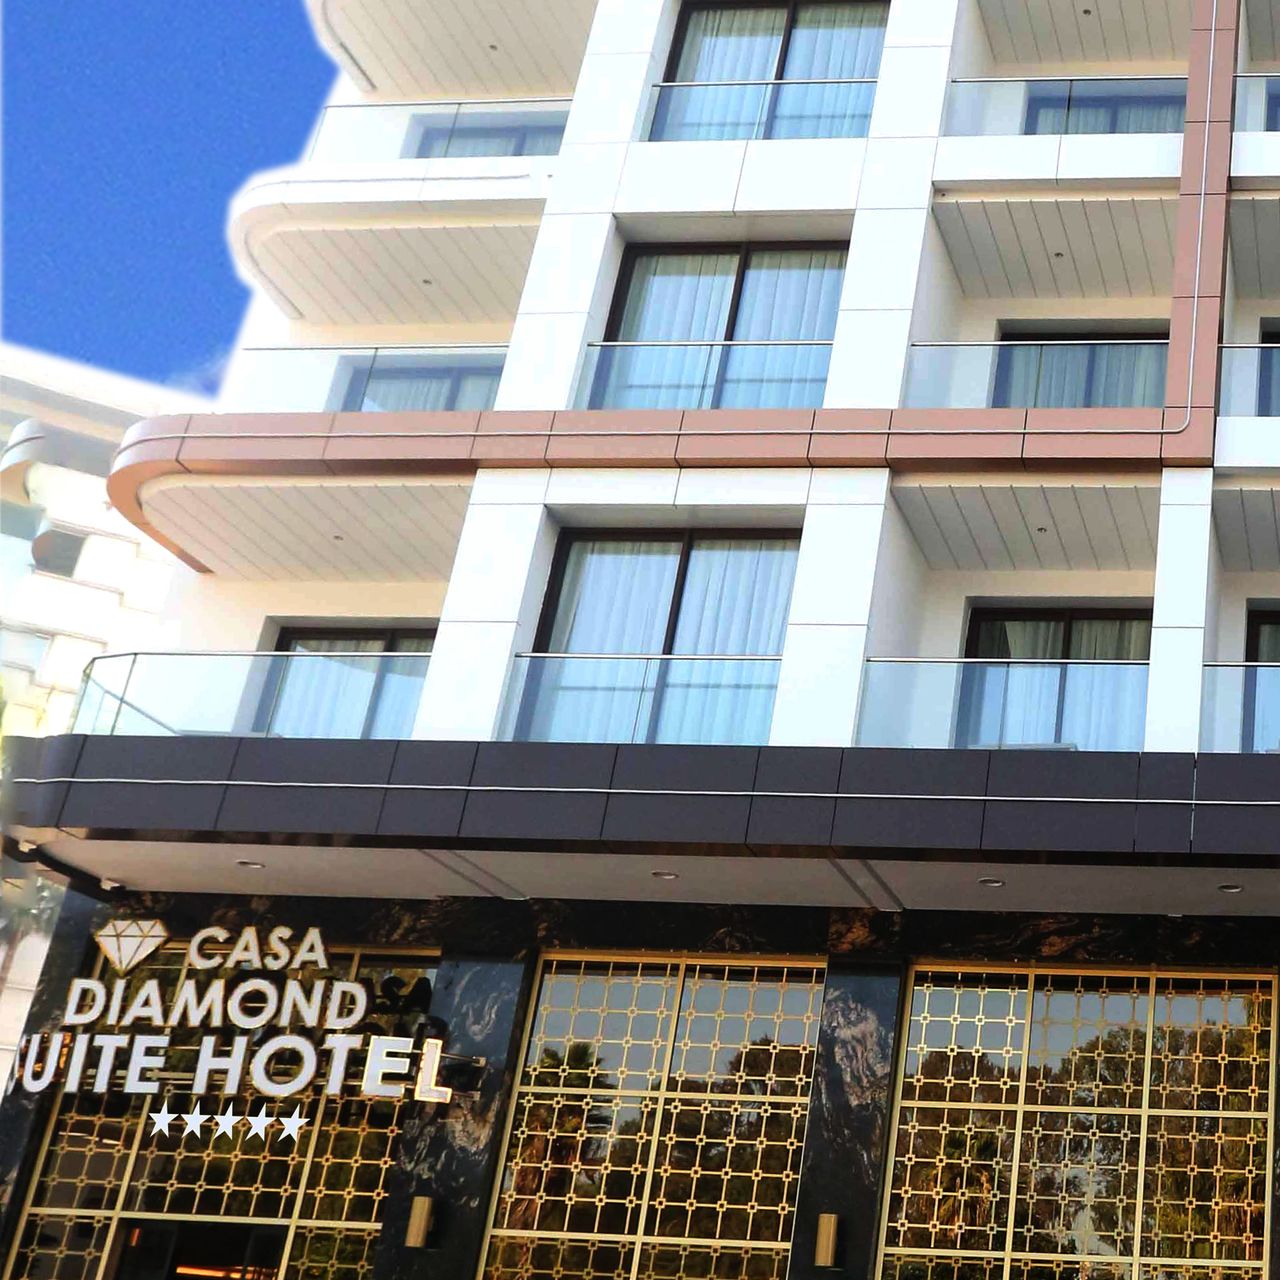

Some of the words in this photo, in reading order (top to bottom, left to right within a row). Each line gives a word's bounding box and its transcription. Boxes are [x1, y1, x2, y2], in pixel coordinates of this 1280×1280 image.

[189, 926, 329, 970] CASA
[63, 978, 367, 1030] DIAMOND
[191, 1034, 452, 1104] HOTEL
